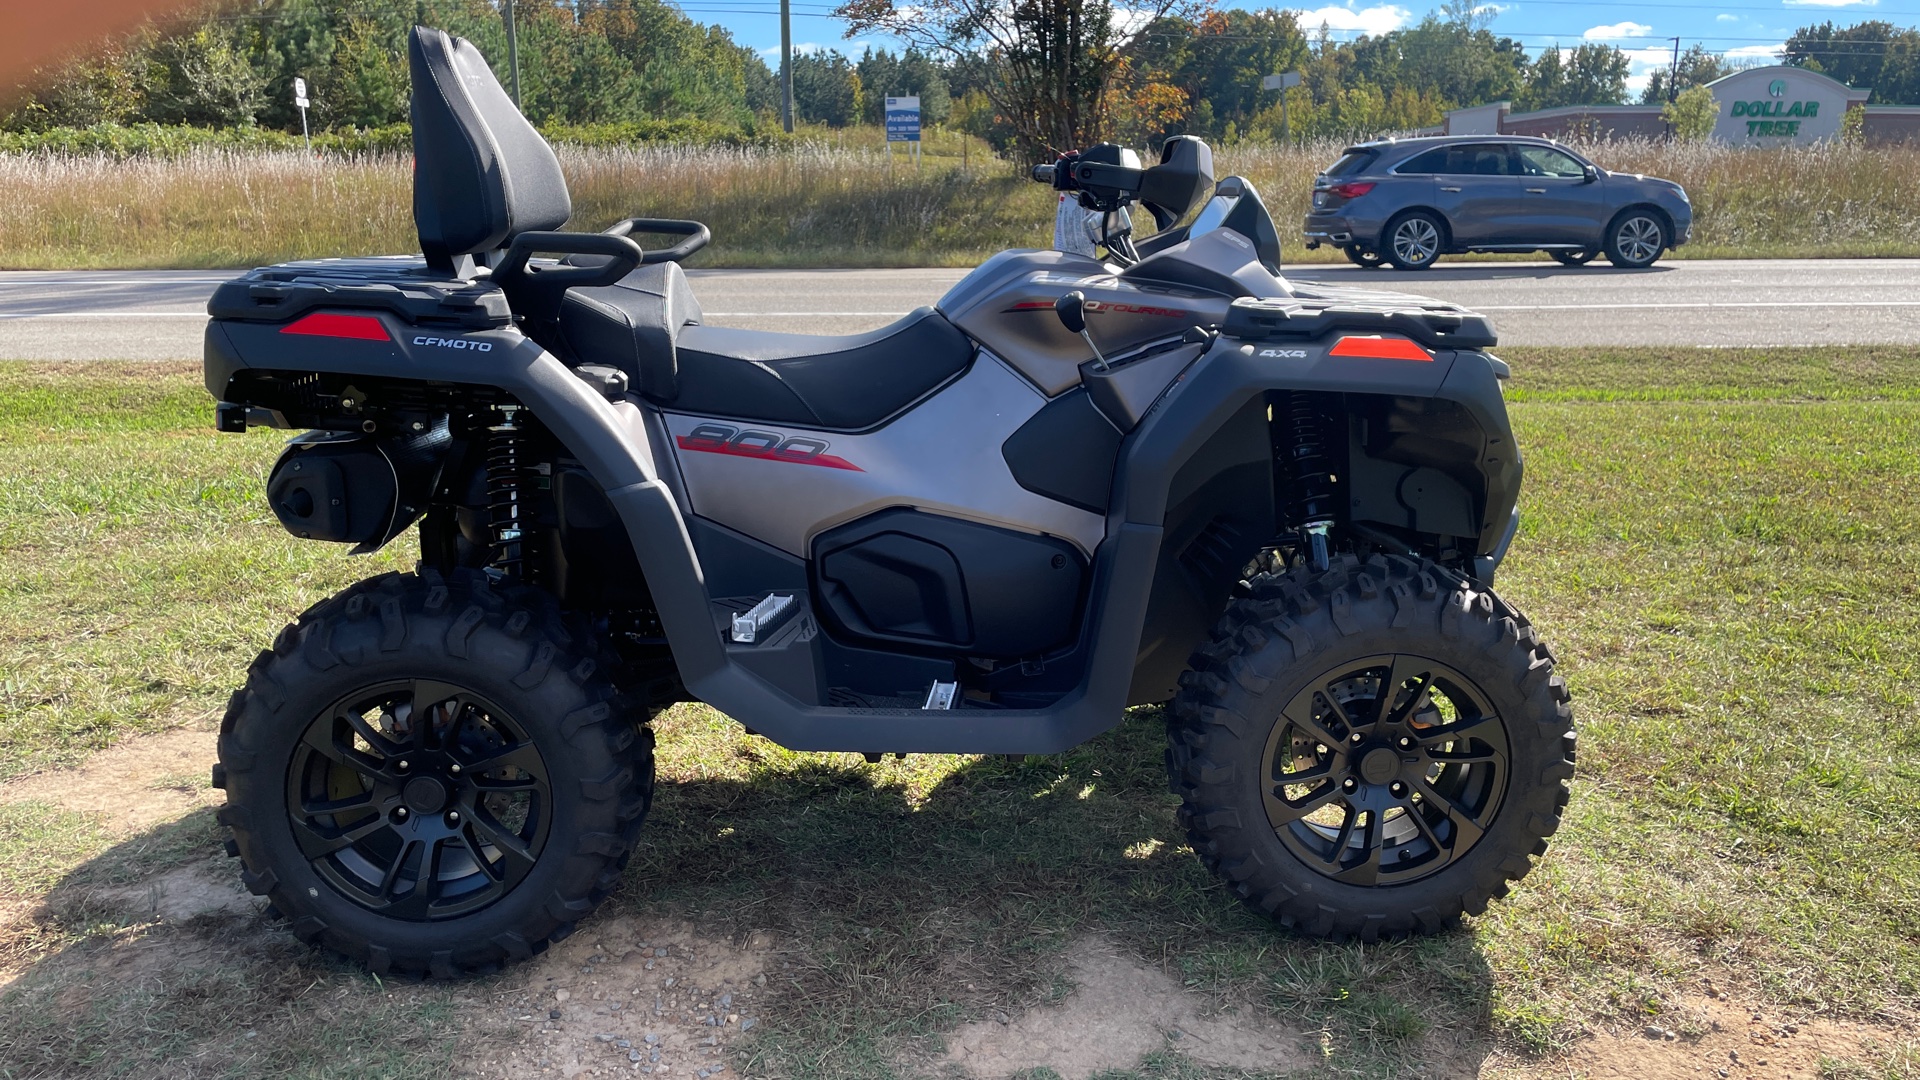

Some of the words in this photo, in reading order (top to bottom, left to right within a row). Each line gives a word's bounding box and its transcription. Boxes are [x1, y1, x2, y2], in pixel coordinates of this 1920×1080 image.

[1730, 101, 1820, 117] DOLLAR
[887, 114, 919, 122] Available
[1746, 121, 1801, 137] TREE
[1222, 231, 1250, 249] EPS
[413, 336, 493, 352] CFMOTO
[684, 422, 831, 461] 800
